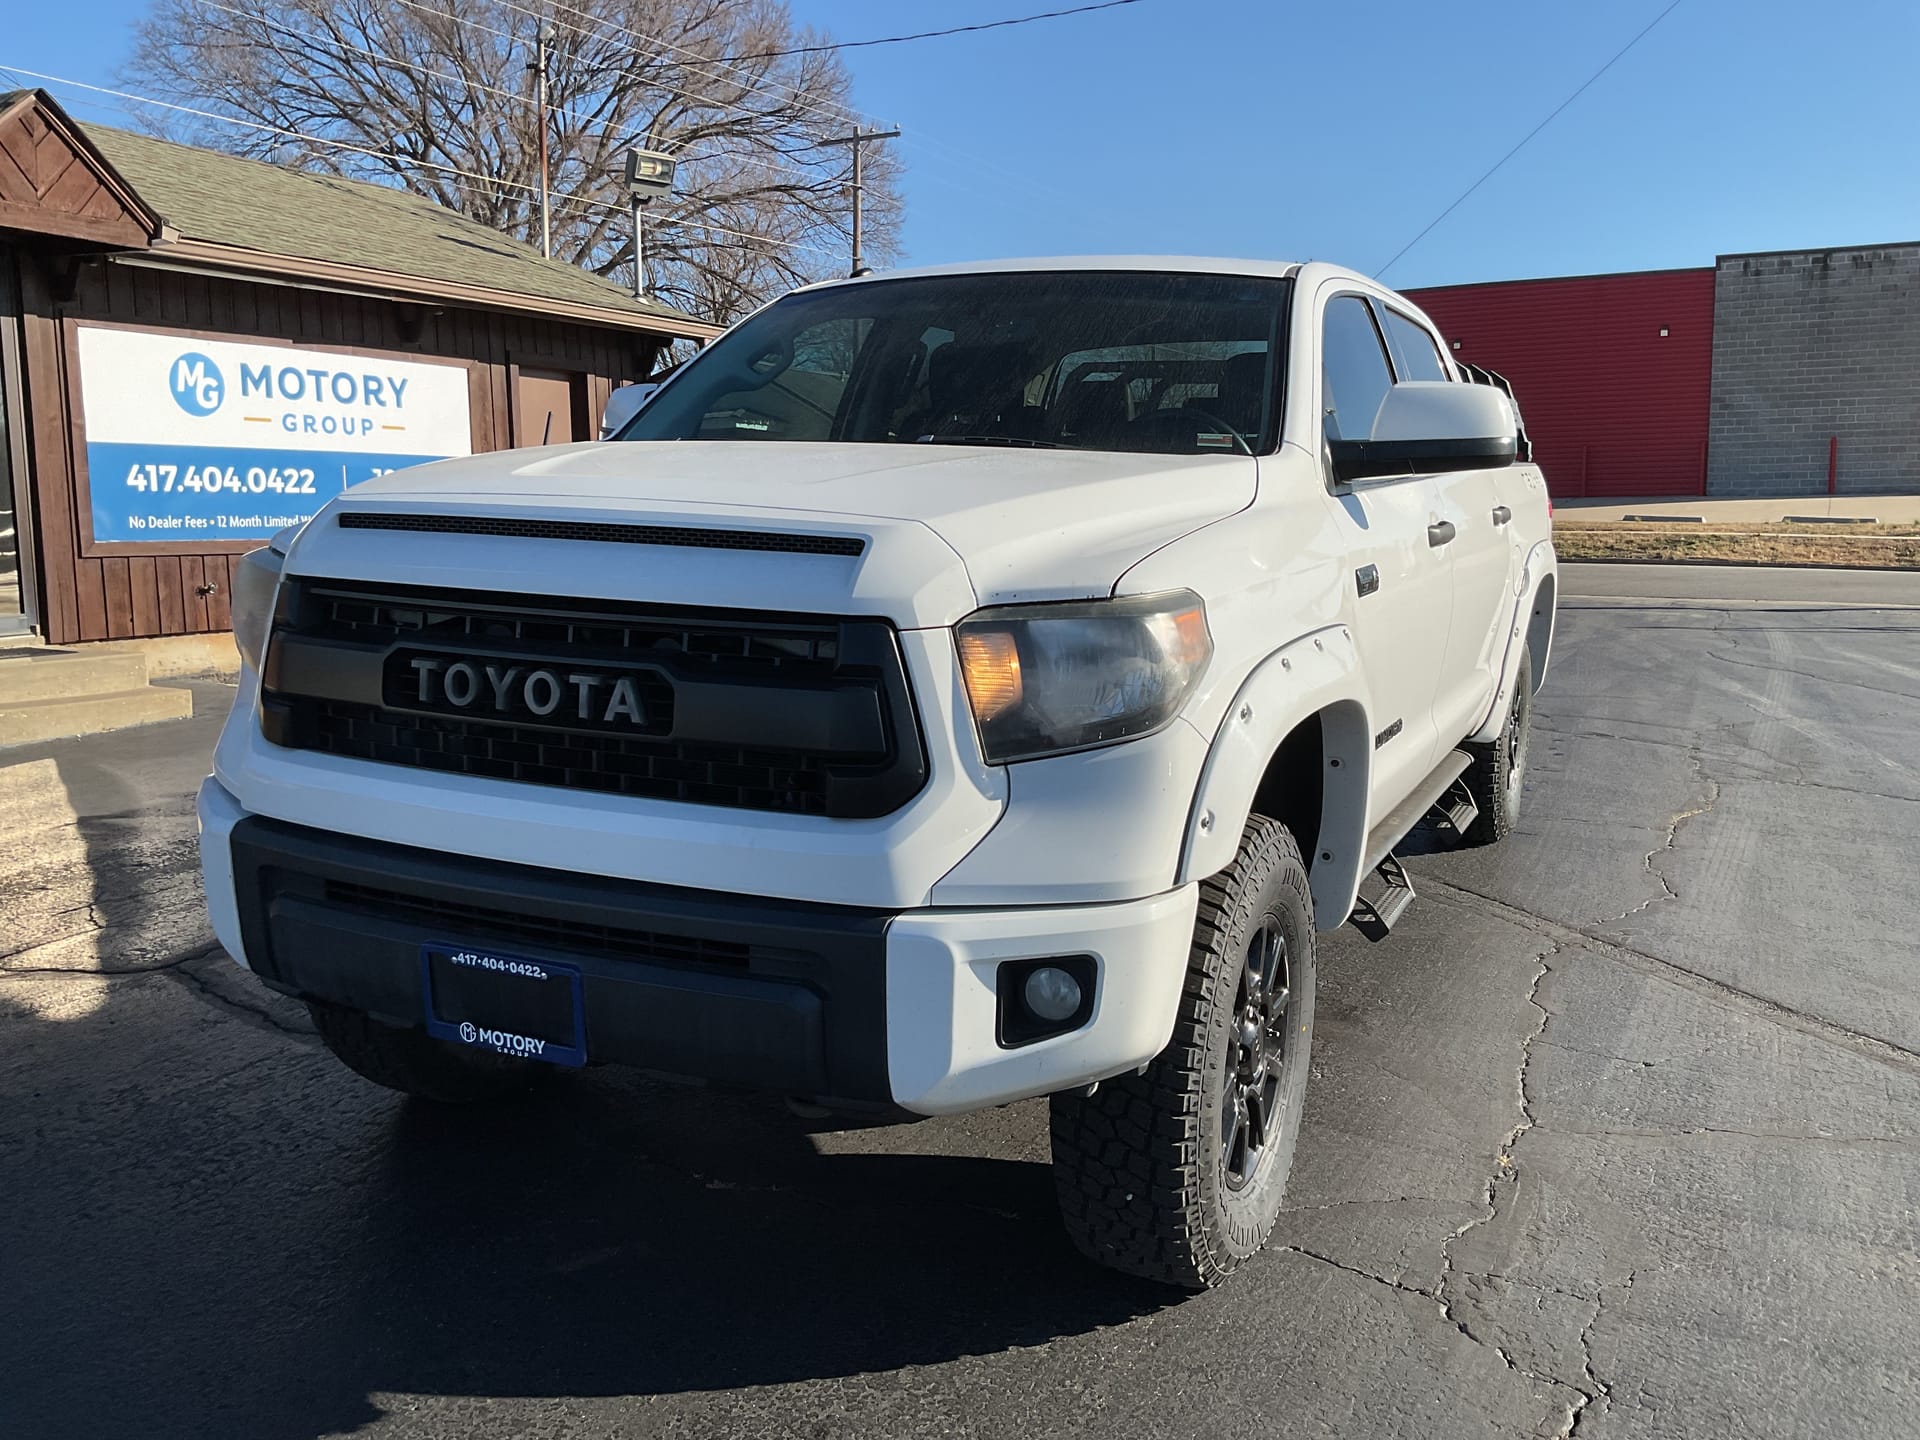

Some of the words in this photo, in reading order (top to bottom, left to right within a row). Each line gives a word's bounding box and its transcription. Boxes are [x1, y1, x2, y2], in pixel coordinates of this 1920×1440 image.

[240, 362, 409, 408] MOTORY
[281, 412, 374, 437] GROUP
[126, 464, 317, 494] 417.404.0422
[129, 516, 146, 529] No
[149, 515, 182, 529] Dealer
[185, 516, 208, 529] Fees
[217, 515, 227, 528] 12
[229, 516, 262, 528] Month
[264, 515, 299, 528] Limited
[411, 657, 646, 724] TOYOTA
[479, 1028, 546, 1054] MOTORY
[497, 1046, 529, 1057] GROUP
